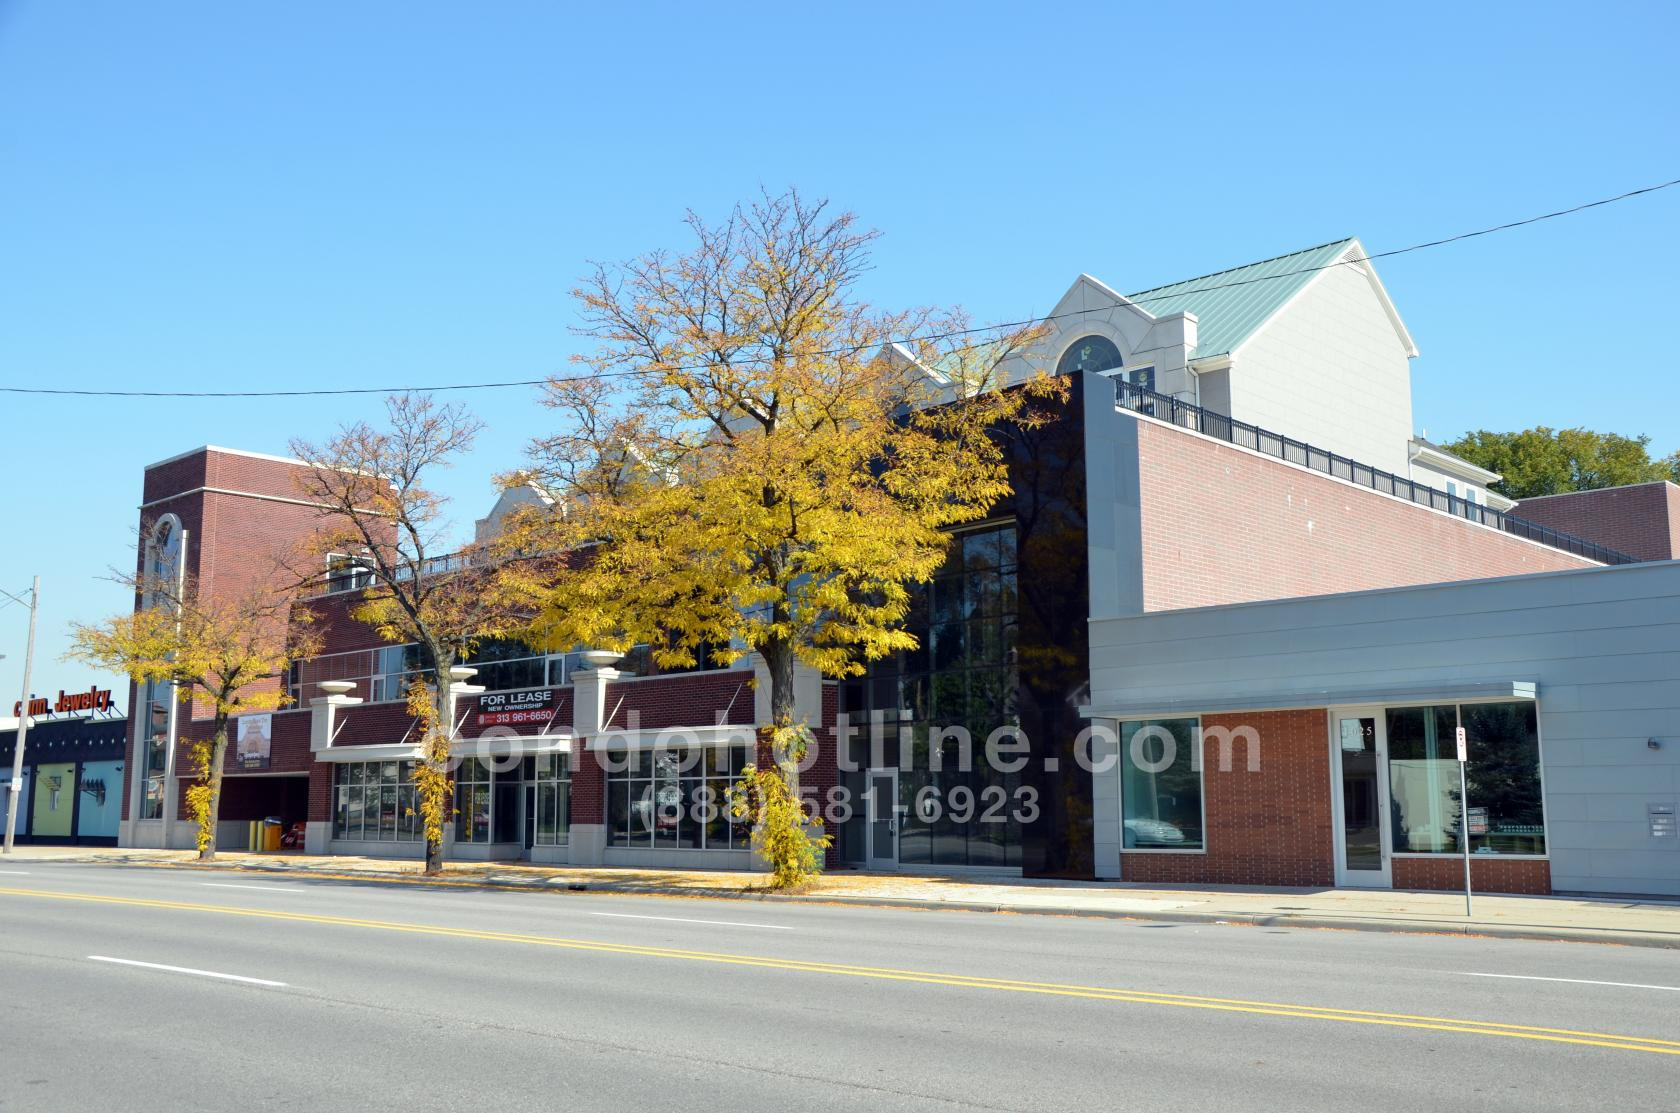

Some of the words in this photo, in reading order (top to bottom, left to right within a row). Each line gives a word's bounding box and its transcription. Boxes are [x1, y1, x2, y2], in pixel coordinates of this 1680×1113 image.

[55, 685, 111, 712] Jewelry
[480, 695, 505, 705] FOR
[511, 691, 551, 703] LEASE
[505, 703, 543, 711] OWNERSHIP
[497, 714, 509, 722] 313
[513, 711, 551, 721] 961-6650
